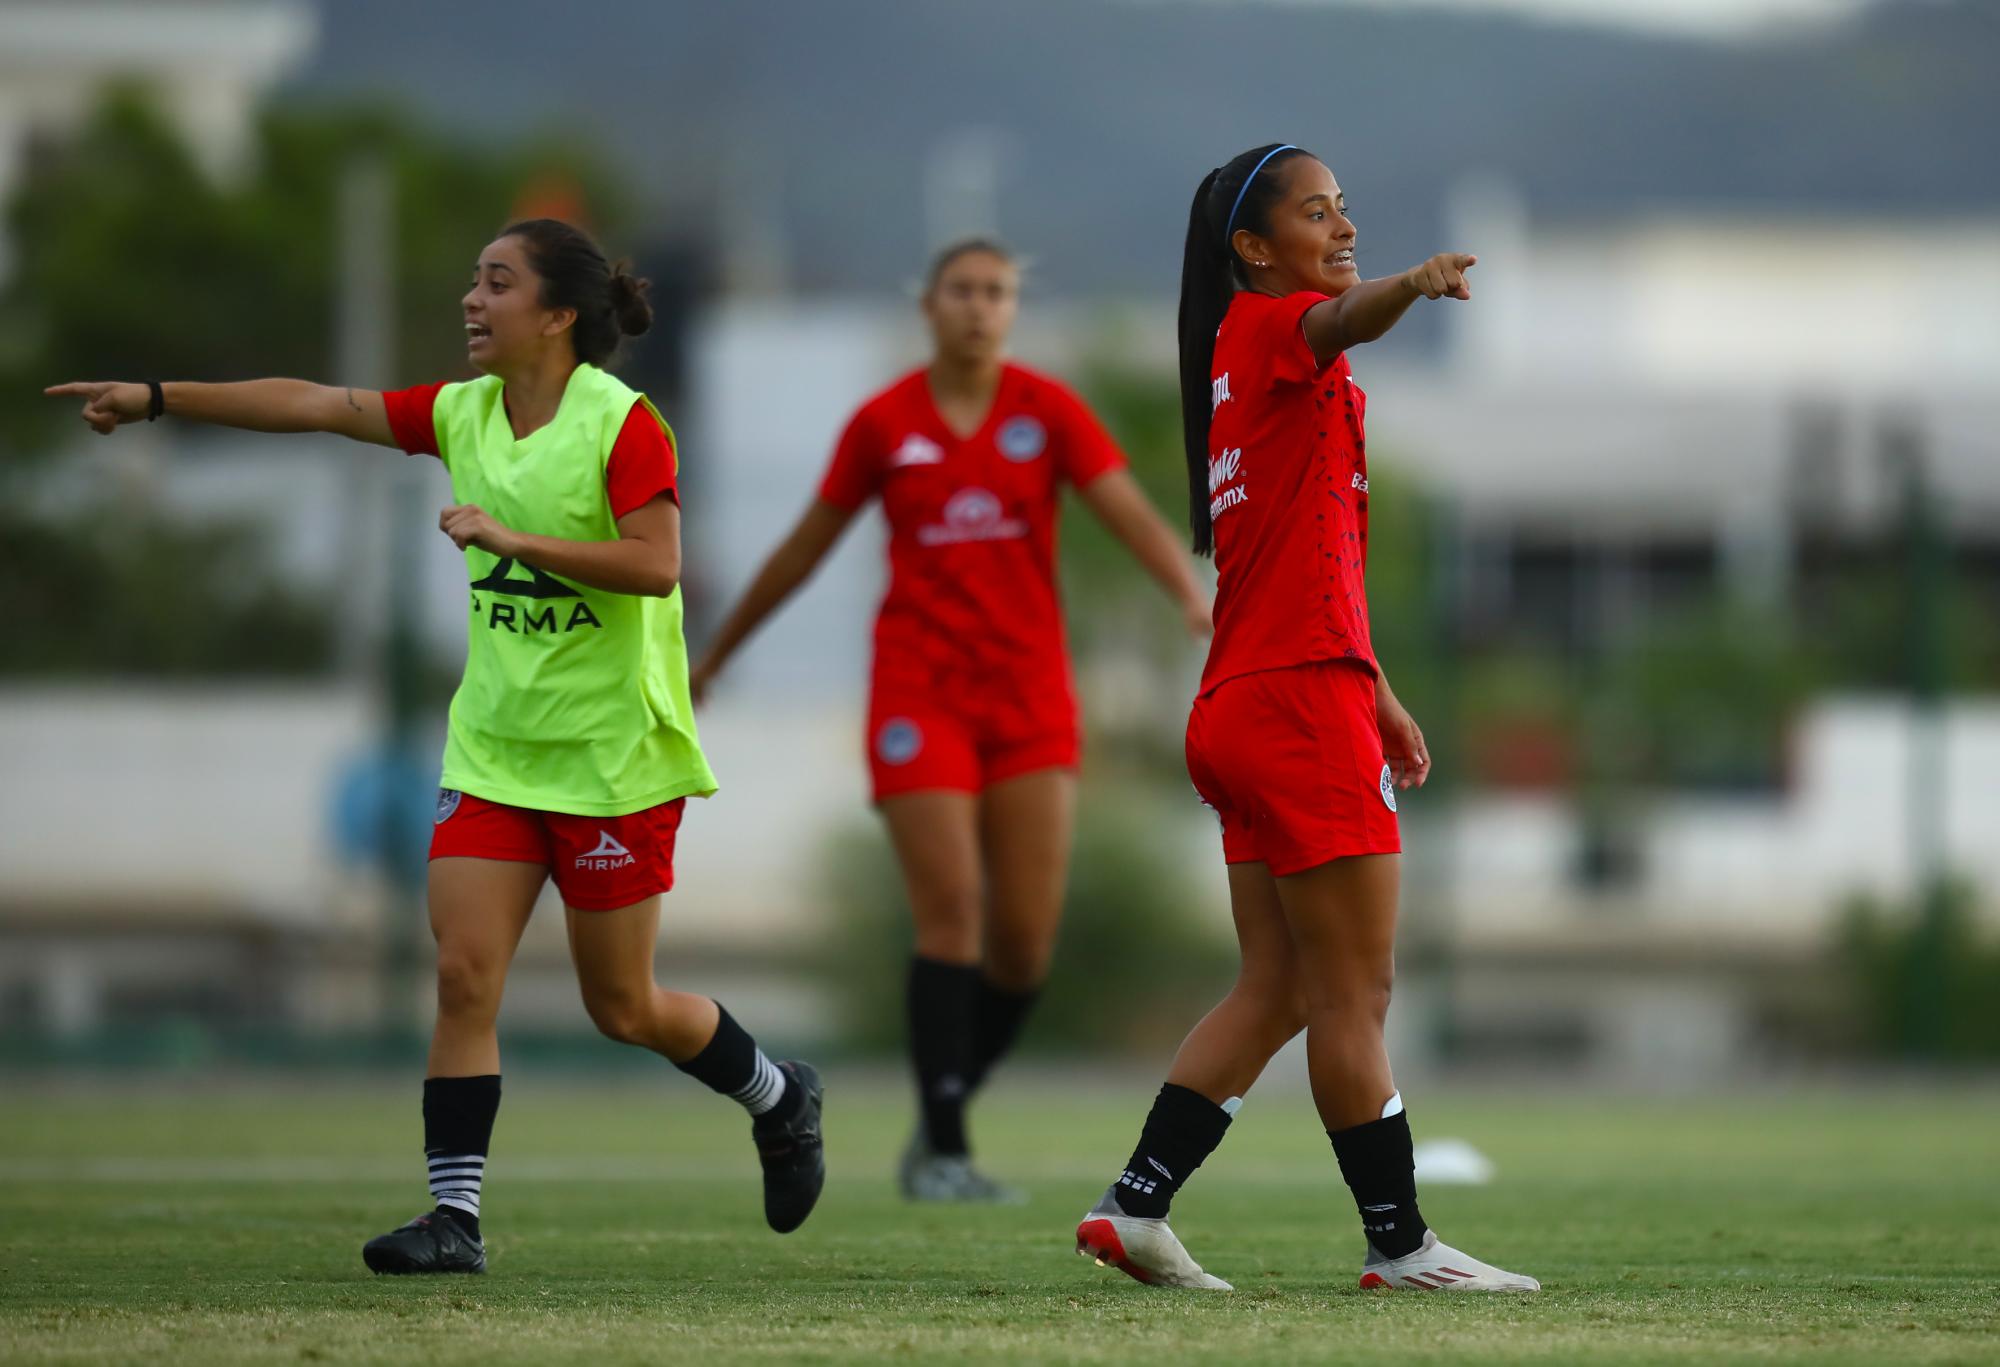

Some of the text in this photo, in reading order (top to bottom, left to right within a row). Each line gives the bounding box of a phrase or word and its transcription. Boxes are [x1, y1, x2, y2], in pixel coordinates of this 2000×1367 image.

[1351, 472, 1368, 494] Ba
[471, 592, 603, 635] RMA
[575, 854, 636, 870] PIRMA
